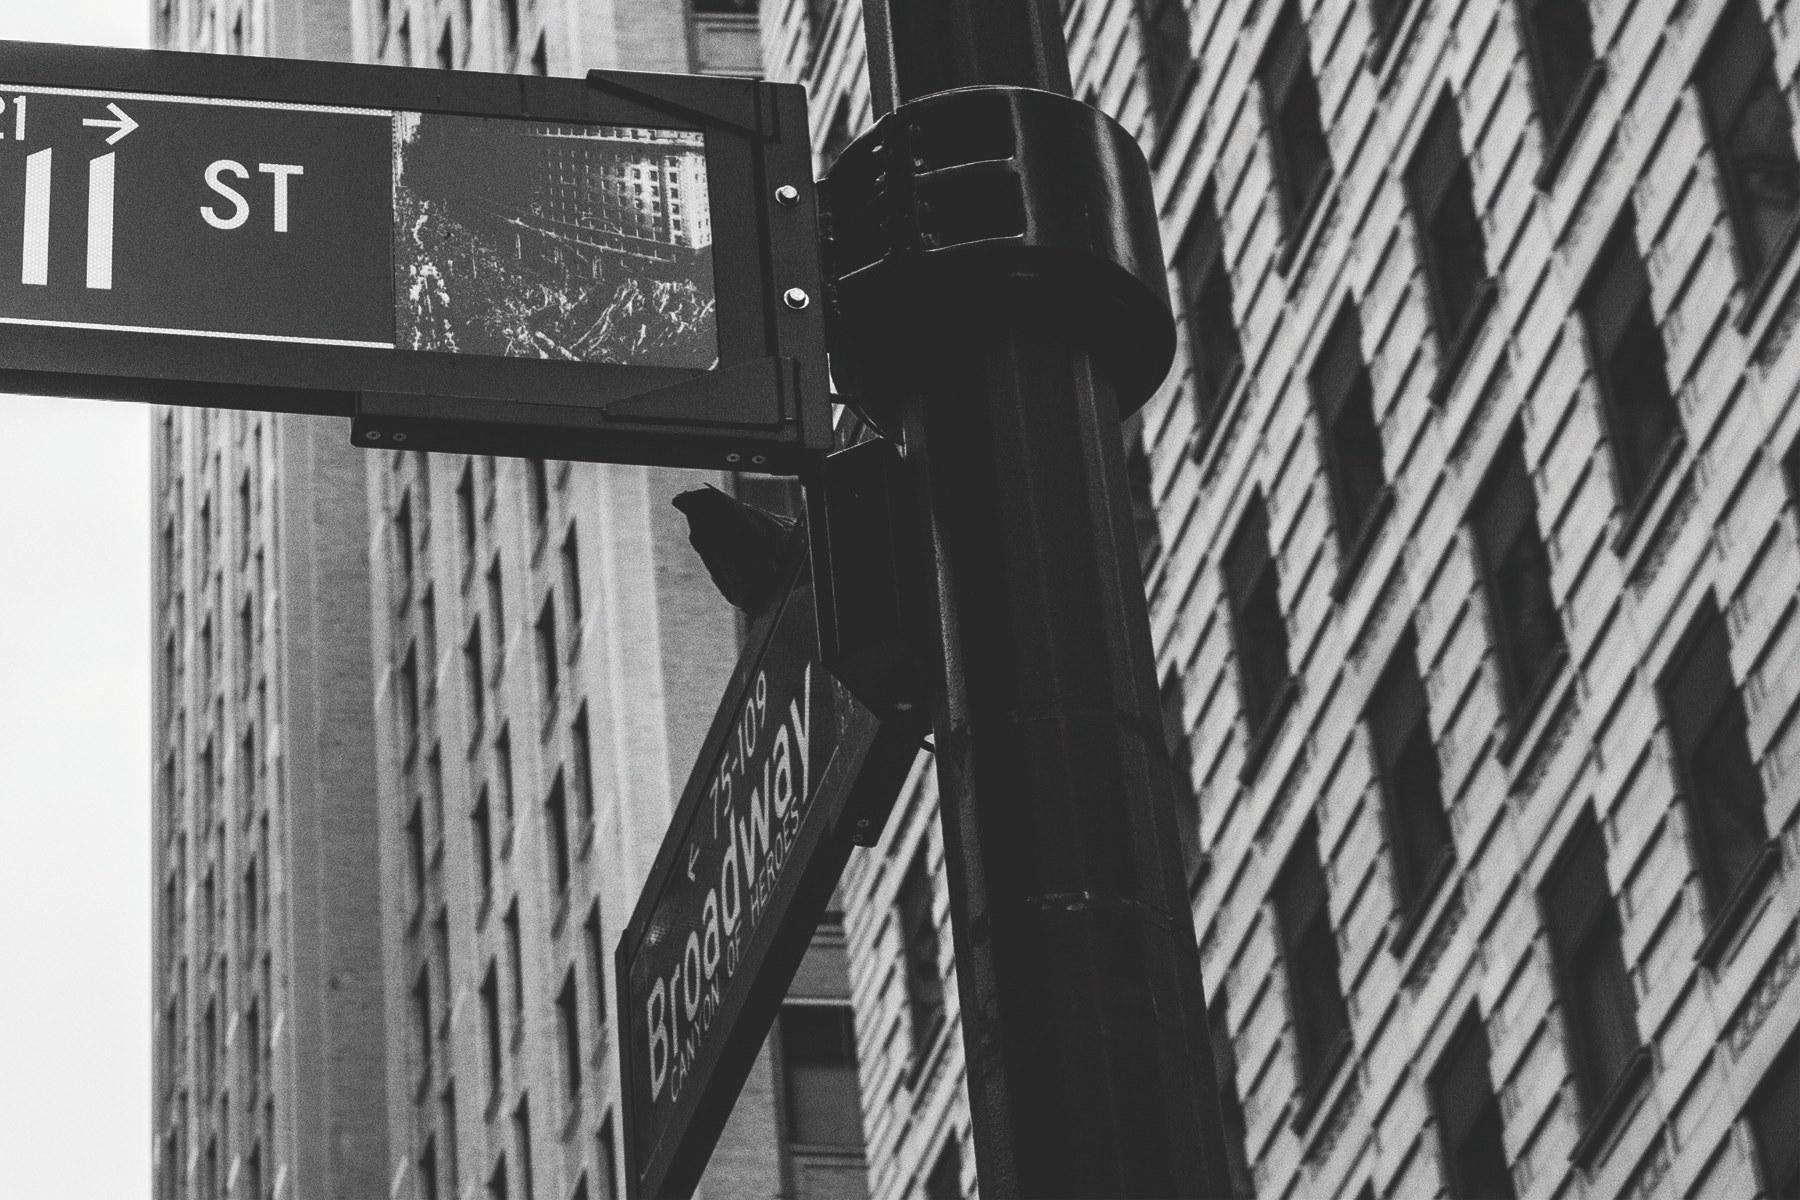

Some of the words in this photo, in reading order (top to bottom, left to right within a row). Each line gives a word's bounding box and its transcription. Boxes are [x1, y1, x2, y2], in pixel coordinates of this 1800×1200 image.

[198, 158, 305, 234] ST
[709, 669, 768, 841] 75-109
[646, 660, 813, 1104] Broadway
[670, 971, 721, 1104] CANYON
[726, 918, 744, 980] OF
[749, 795, 801, 928] HEROES
